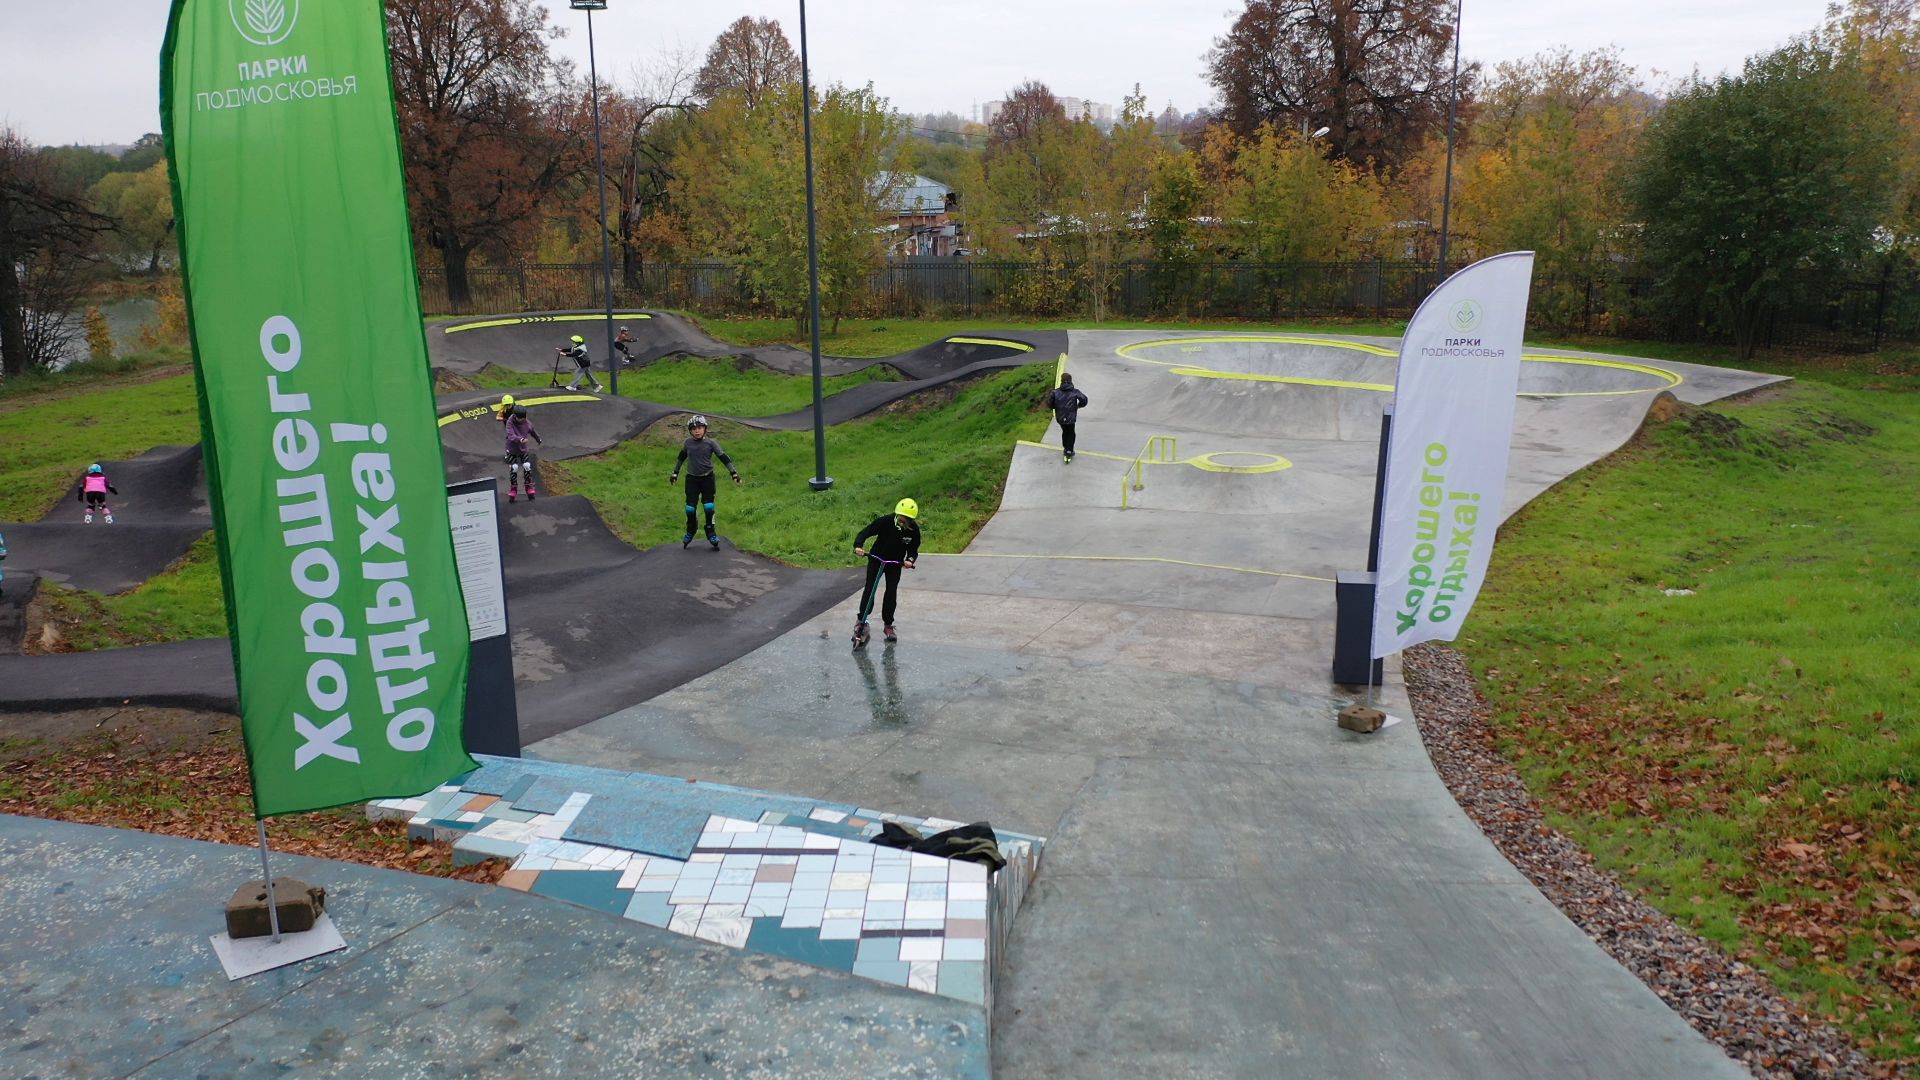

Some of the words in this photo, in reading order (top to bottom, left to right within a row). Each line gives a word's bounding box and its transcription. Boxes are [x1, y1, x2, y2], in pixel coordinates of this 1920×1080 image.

[196, 75, 357, 111] ПОДМОСКОВЬЯ
[238, 55, 308, 81] ПАРКИ
[1421, 347, 1505, 358] ПОДМОСКОВЬЯ
[1445, 338, 1481, 347] ПАРКИ
[259, 315, 360, 771] Хорошего
[1396, 442, 1448, 636] Хорошего
[1428, 491, 1481, 623] отдыха!
[329, 421, 436, 752] отдыха!
